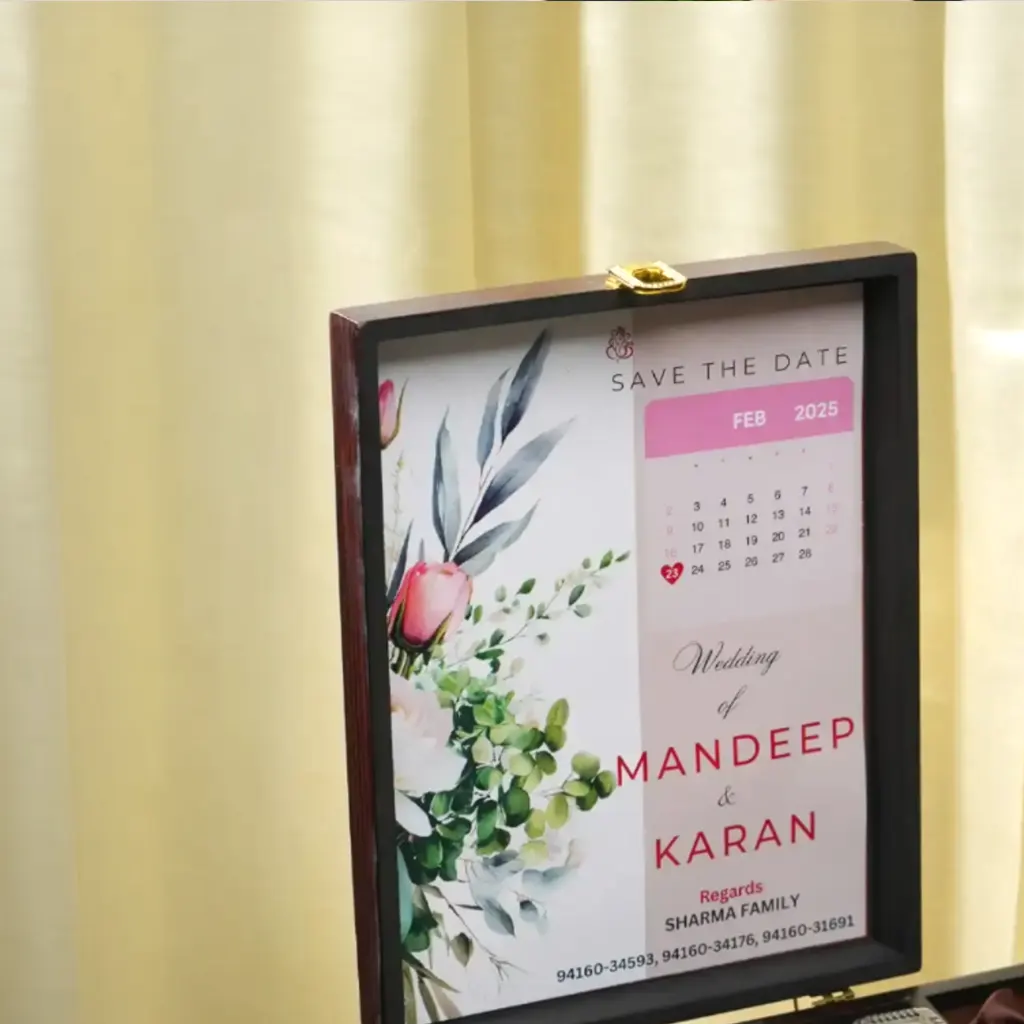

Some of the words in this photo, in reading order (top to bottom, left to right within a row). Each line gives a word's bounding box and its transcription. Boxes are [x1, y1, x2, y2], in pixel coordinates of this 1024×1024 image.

[612, 366, 685, 392] SAVE
[703, 357, 757, 380] THE
[775, 346, 848, 372] DATE
[733, 410, 766, 429] FEB
[794, 401, 839, 422] 2025
[693, 501, 701, 512] 3
[720, 498, 727, 508] 4
[747, 494, 754, 504] 5
[774, 490, 781, 500] 6
[801, 486, 808, 497] 7
[691, 521, 704, 532] 10
[718, 518, 730, 529] 11
[746, 514, 758, 525] 12
[772, 510, 785, 521] 13
[799, 506, 811, 517] 14
[693, 543, 704, 554] 17
[719, 539, 731, 550] 18
[746, 536, 758, 546] 19
[772, 532, 785, 542] 20
[798, 527, 811, 538] 21
[665, 567, 679, 580] 23
[691, 564, 704, 575] 24
[718, 560, 731, 571] 25
[745, 556, 758, 568] 26
[772, 552, 785, 564] 27
[798, 549, 812, 560] 28
[672, 641, 780, 676] Wedding
[717, 685, 747, 719] of
[616, 716, 855, 787] MANDEEP
[717, 786, 736, 807] &
[655, 811, 816, 869] KARAN
[700, 880, 763, 904] Regards
[665, 906, 737, 932] SHARMA
[741, 893, 801, 918] FAMILY
[556, 952, 659, 983] 94160-34593,
[662, 934, 758, 962] 94160-34176,
[762, 914, 854, 943] 94160-31691
